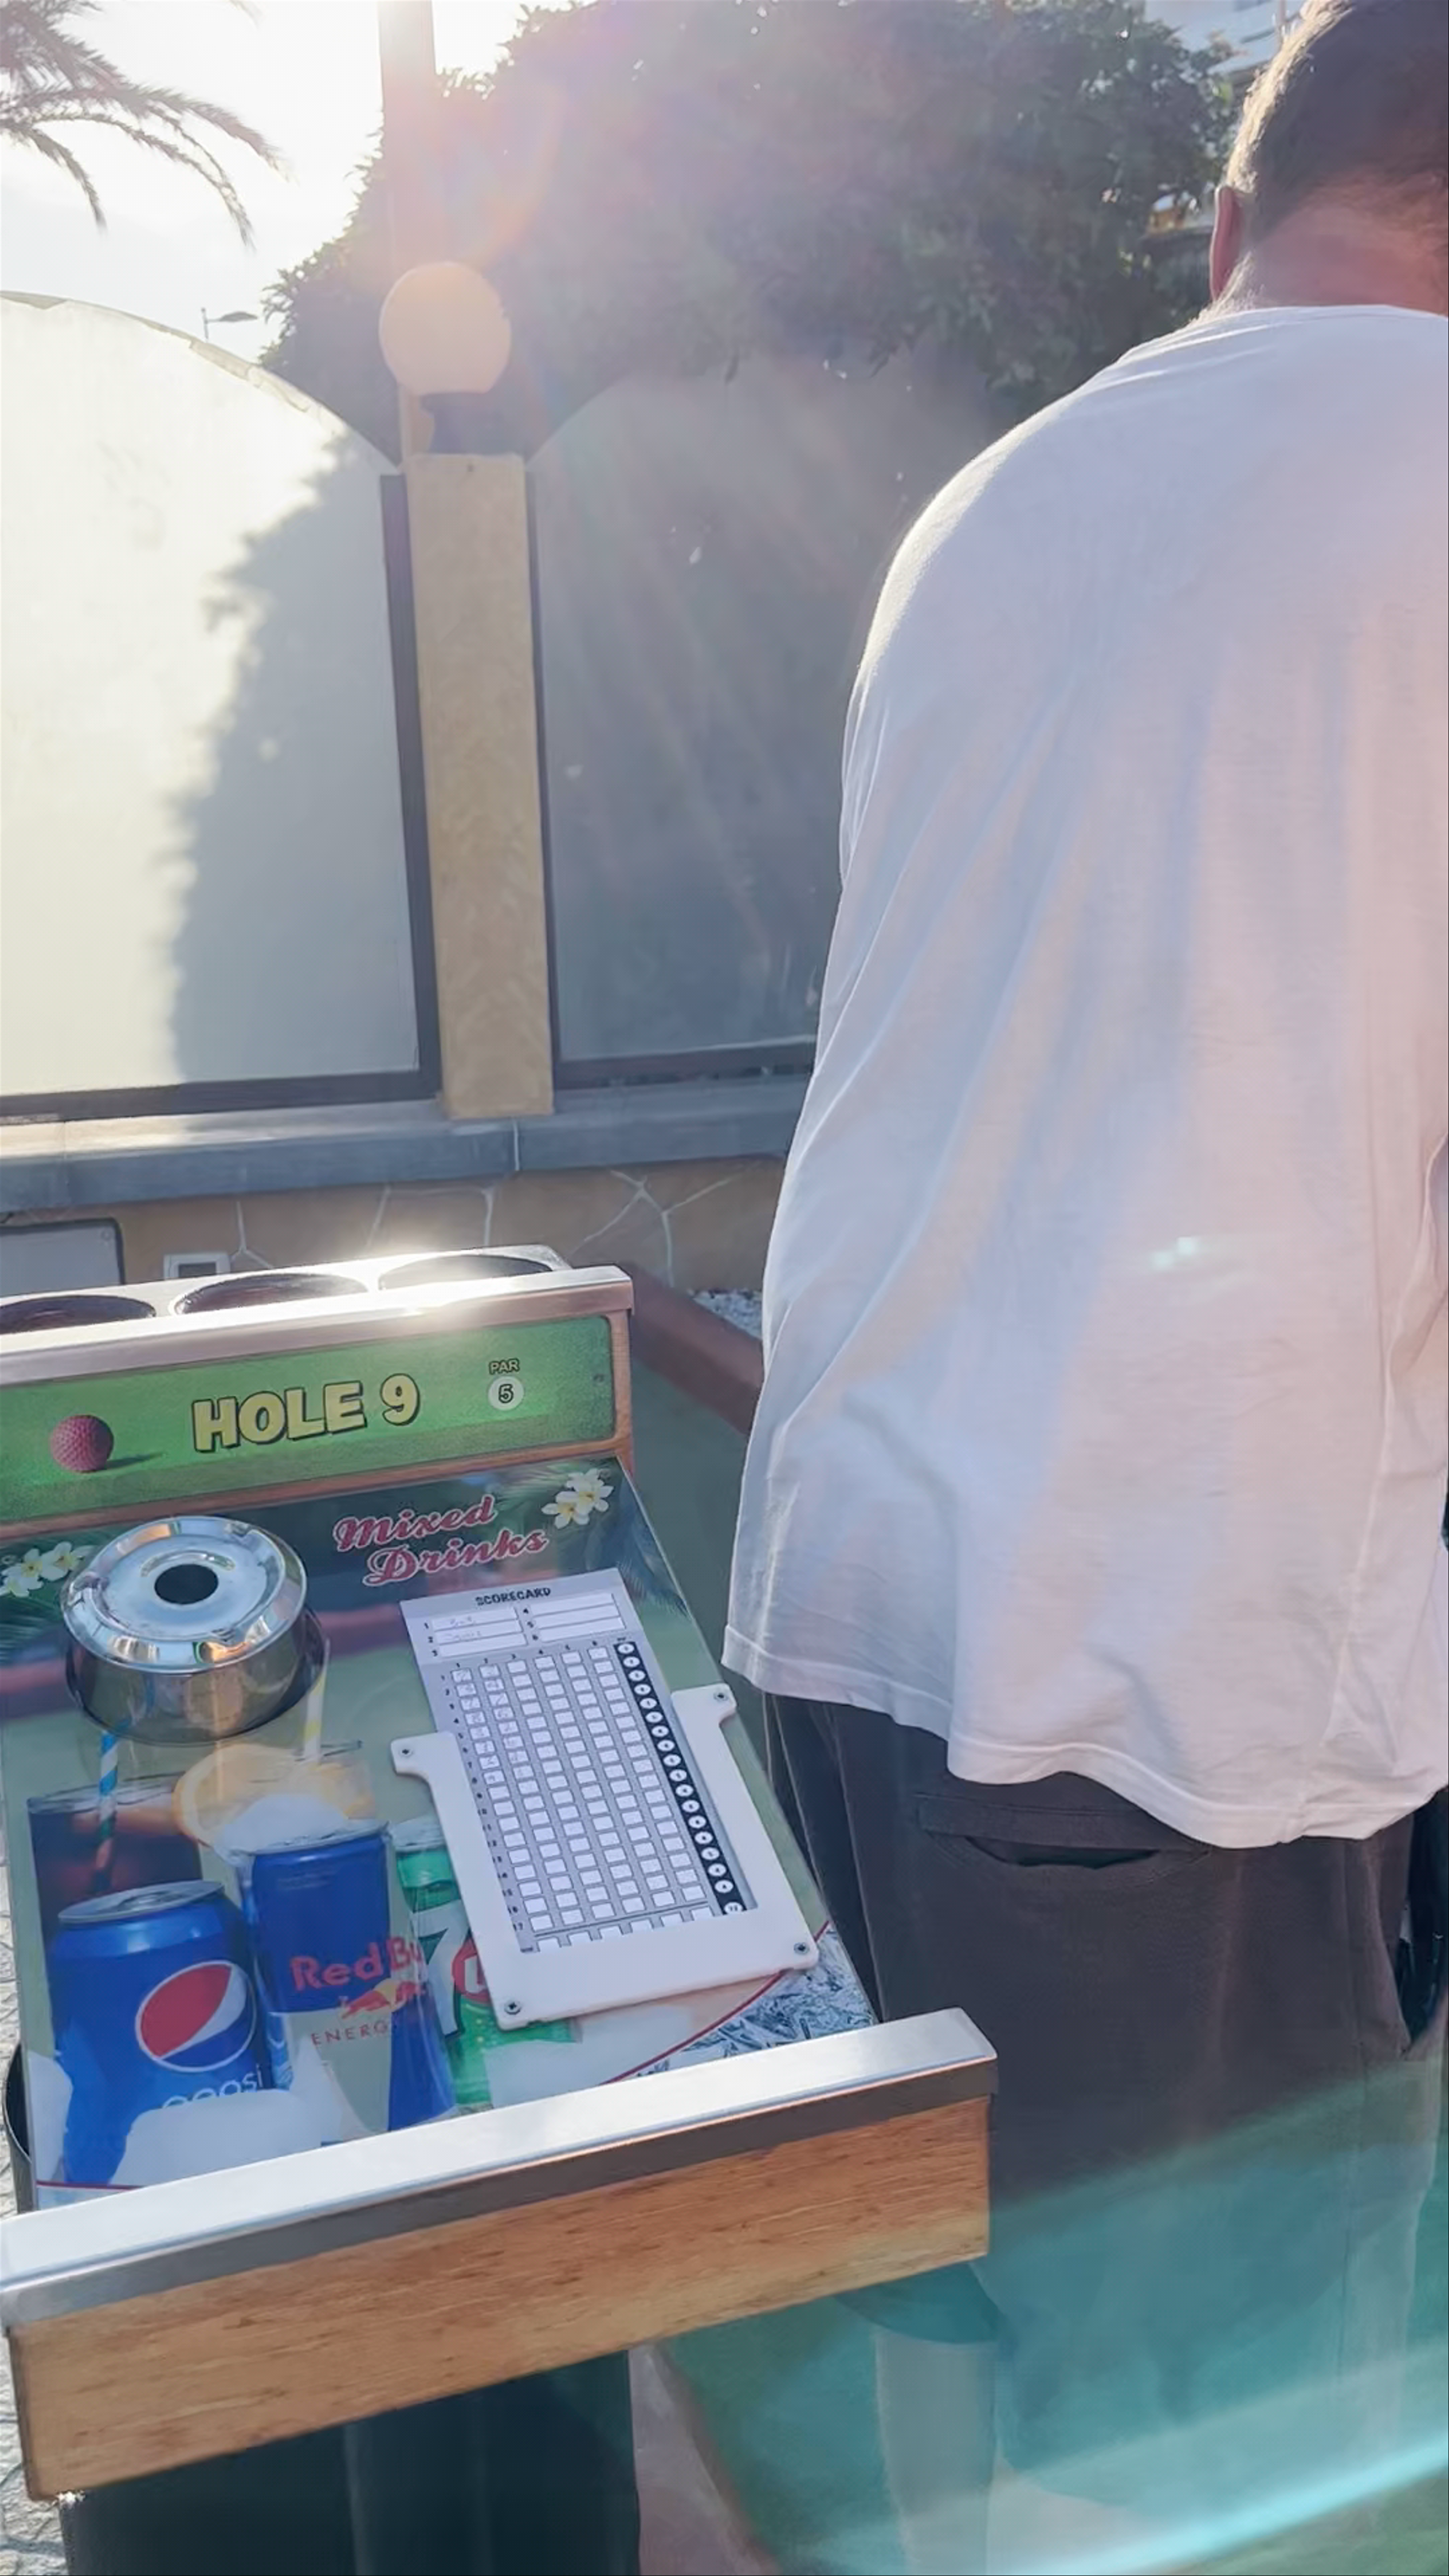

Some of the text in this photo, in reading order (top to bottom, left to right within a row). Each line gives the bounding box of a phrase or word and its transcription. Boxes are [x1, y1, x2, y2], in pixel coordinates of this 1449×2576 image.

[489, 1358, 520, 1375] PAR
[498, 1383, 514, 1404] 5
[191, 1373, 420, 1453] HOLE 9
[332, 1494, 497, 1552] Mixed
[363, 1527, 549, 1587] Drinks
[475, 1587, 551, 1606] SCORECARD
[289, 1942, 384, 1990] Red
[311, 2019, 390, 2046] ENERG
